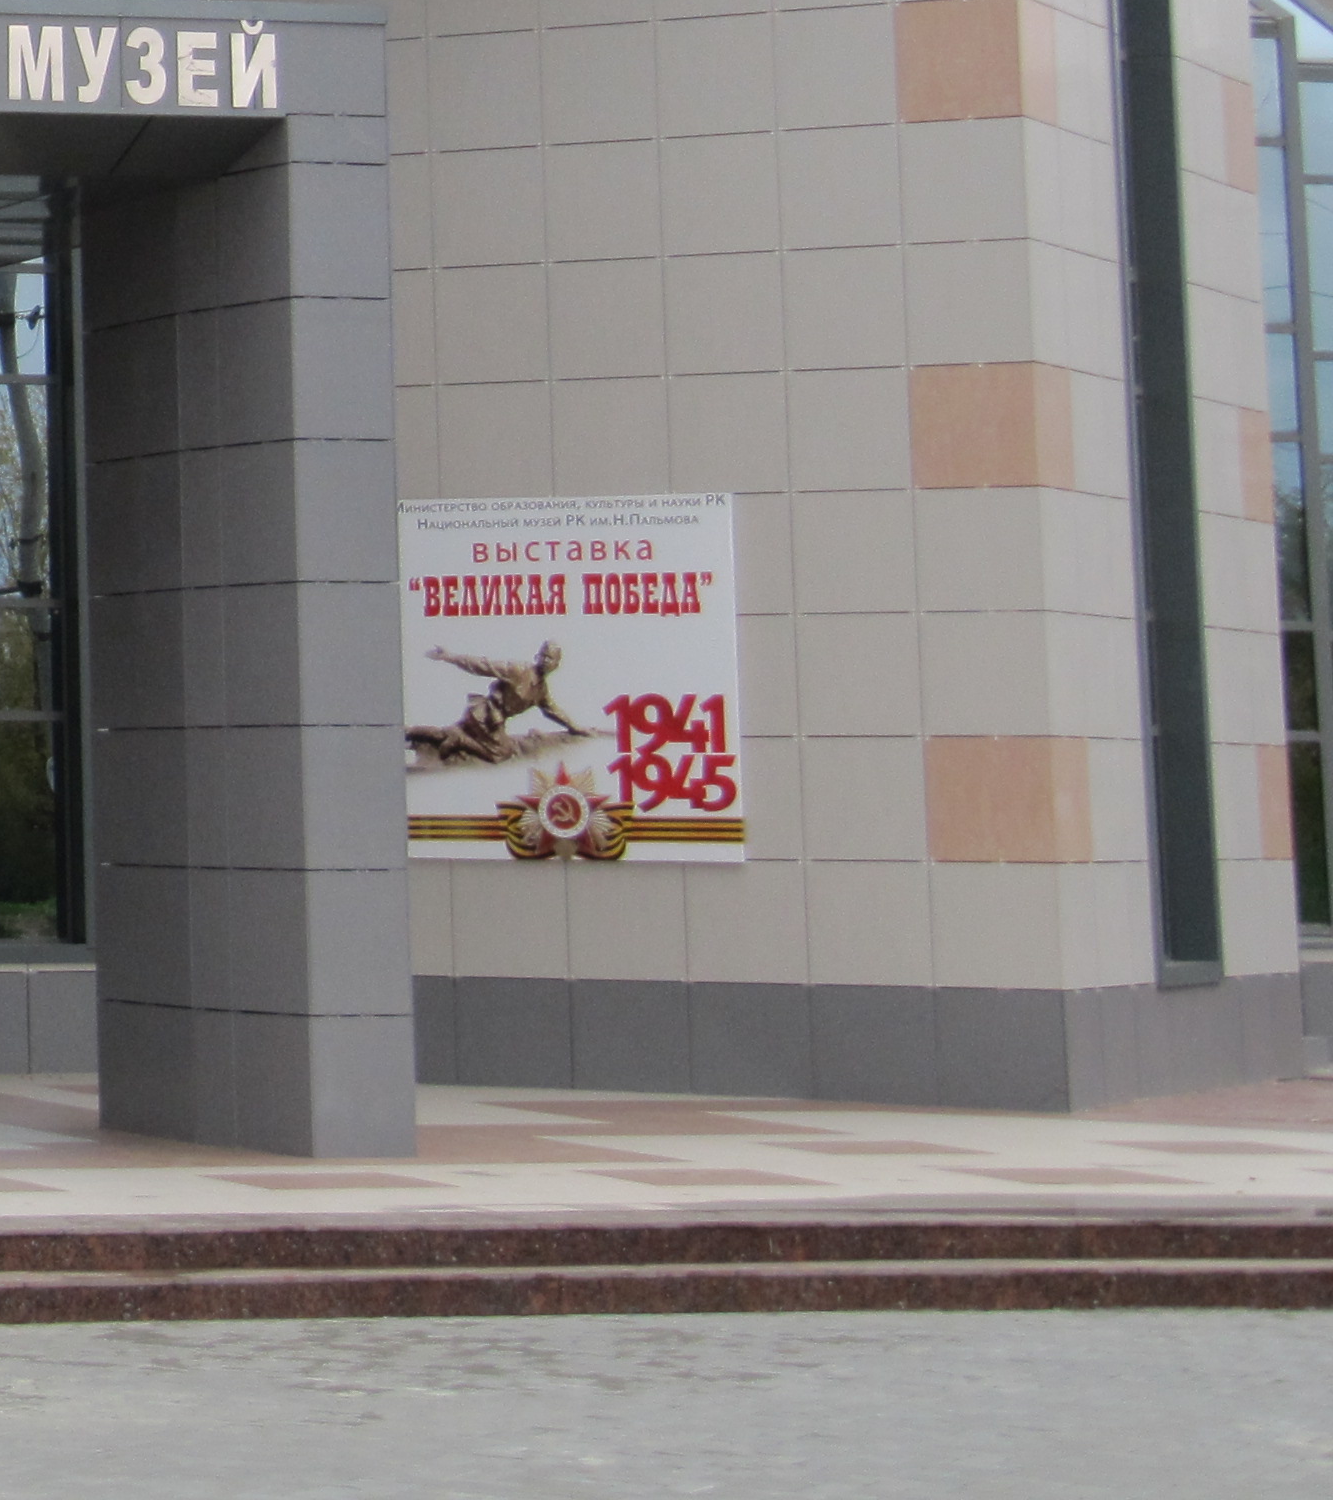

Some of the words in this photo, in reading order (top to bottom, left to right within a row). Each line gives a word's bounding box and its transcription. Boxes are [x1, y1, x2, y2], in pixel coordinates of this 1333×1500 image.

[8, 20, 278, 110] МУЗЕЙ
[602, 692, 727, 755] 1941
[606, 753, 737, 813] 1945
